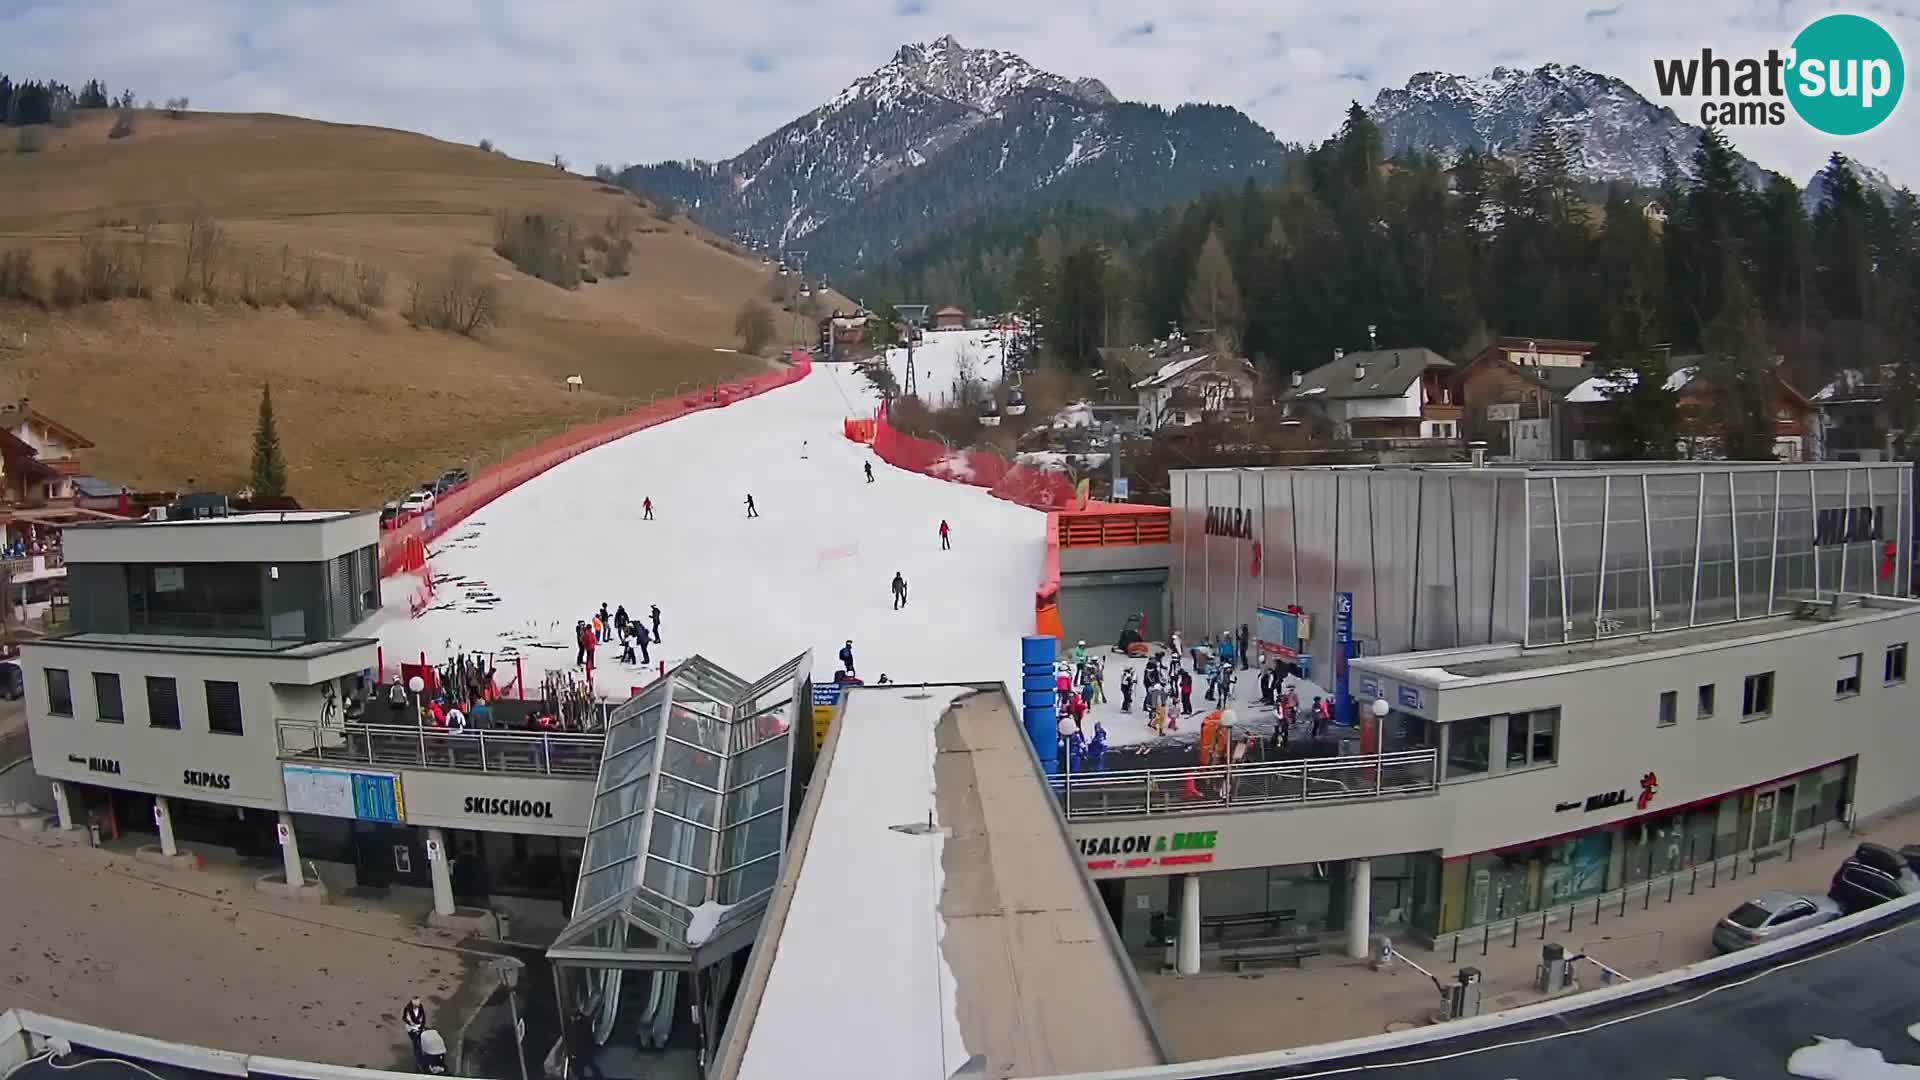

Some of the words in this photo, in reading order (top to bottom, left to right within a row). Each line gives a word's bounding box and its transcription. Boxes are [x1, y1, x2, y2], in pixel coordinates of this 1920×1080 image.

[1205, 506, 1252, 540] MIARA
[183, 769, 230, 789] SKIPASS
[464, 796, 553, 818] SKISCHOOL
[1076, 835, 1151, 855] ISALON
